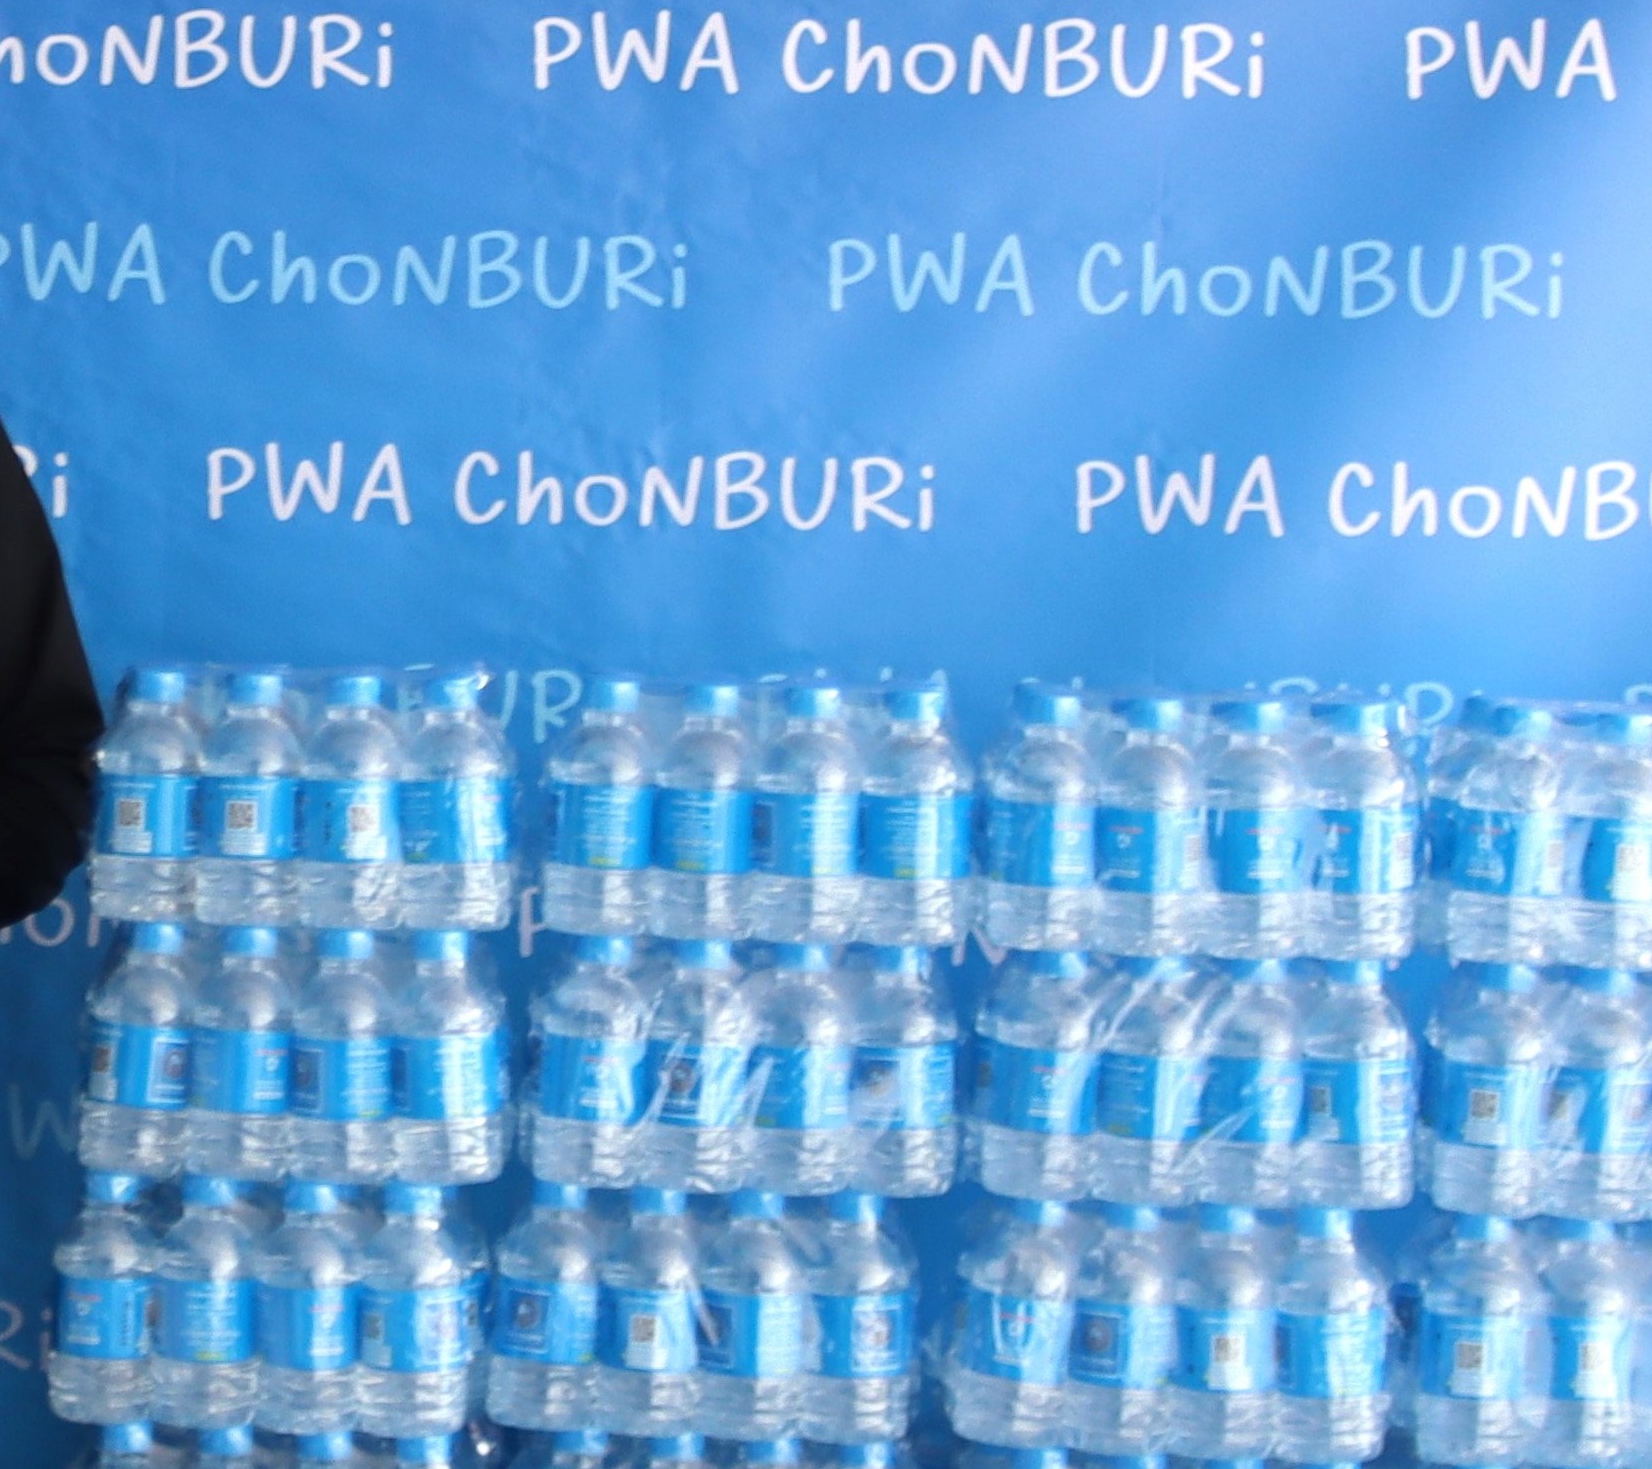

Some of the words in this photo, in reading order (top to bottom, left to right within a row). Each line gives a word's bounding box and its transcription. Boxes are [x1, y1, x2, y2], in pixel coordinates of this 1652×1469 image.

[534, 10, 739, 94] PWA
[1406, 18, 1616, 100] PWA
[829, 232, 1034, 316] PWA
[208, 441, 411, 525] PWA
[1077, 453, 1284, 537] PWA
